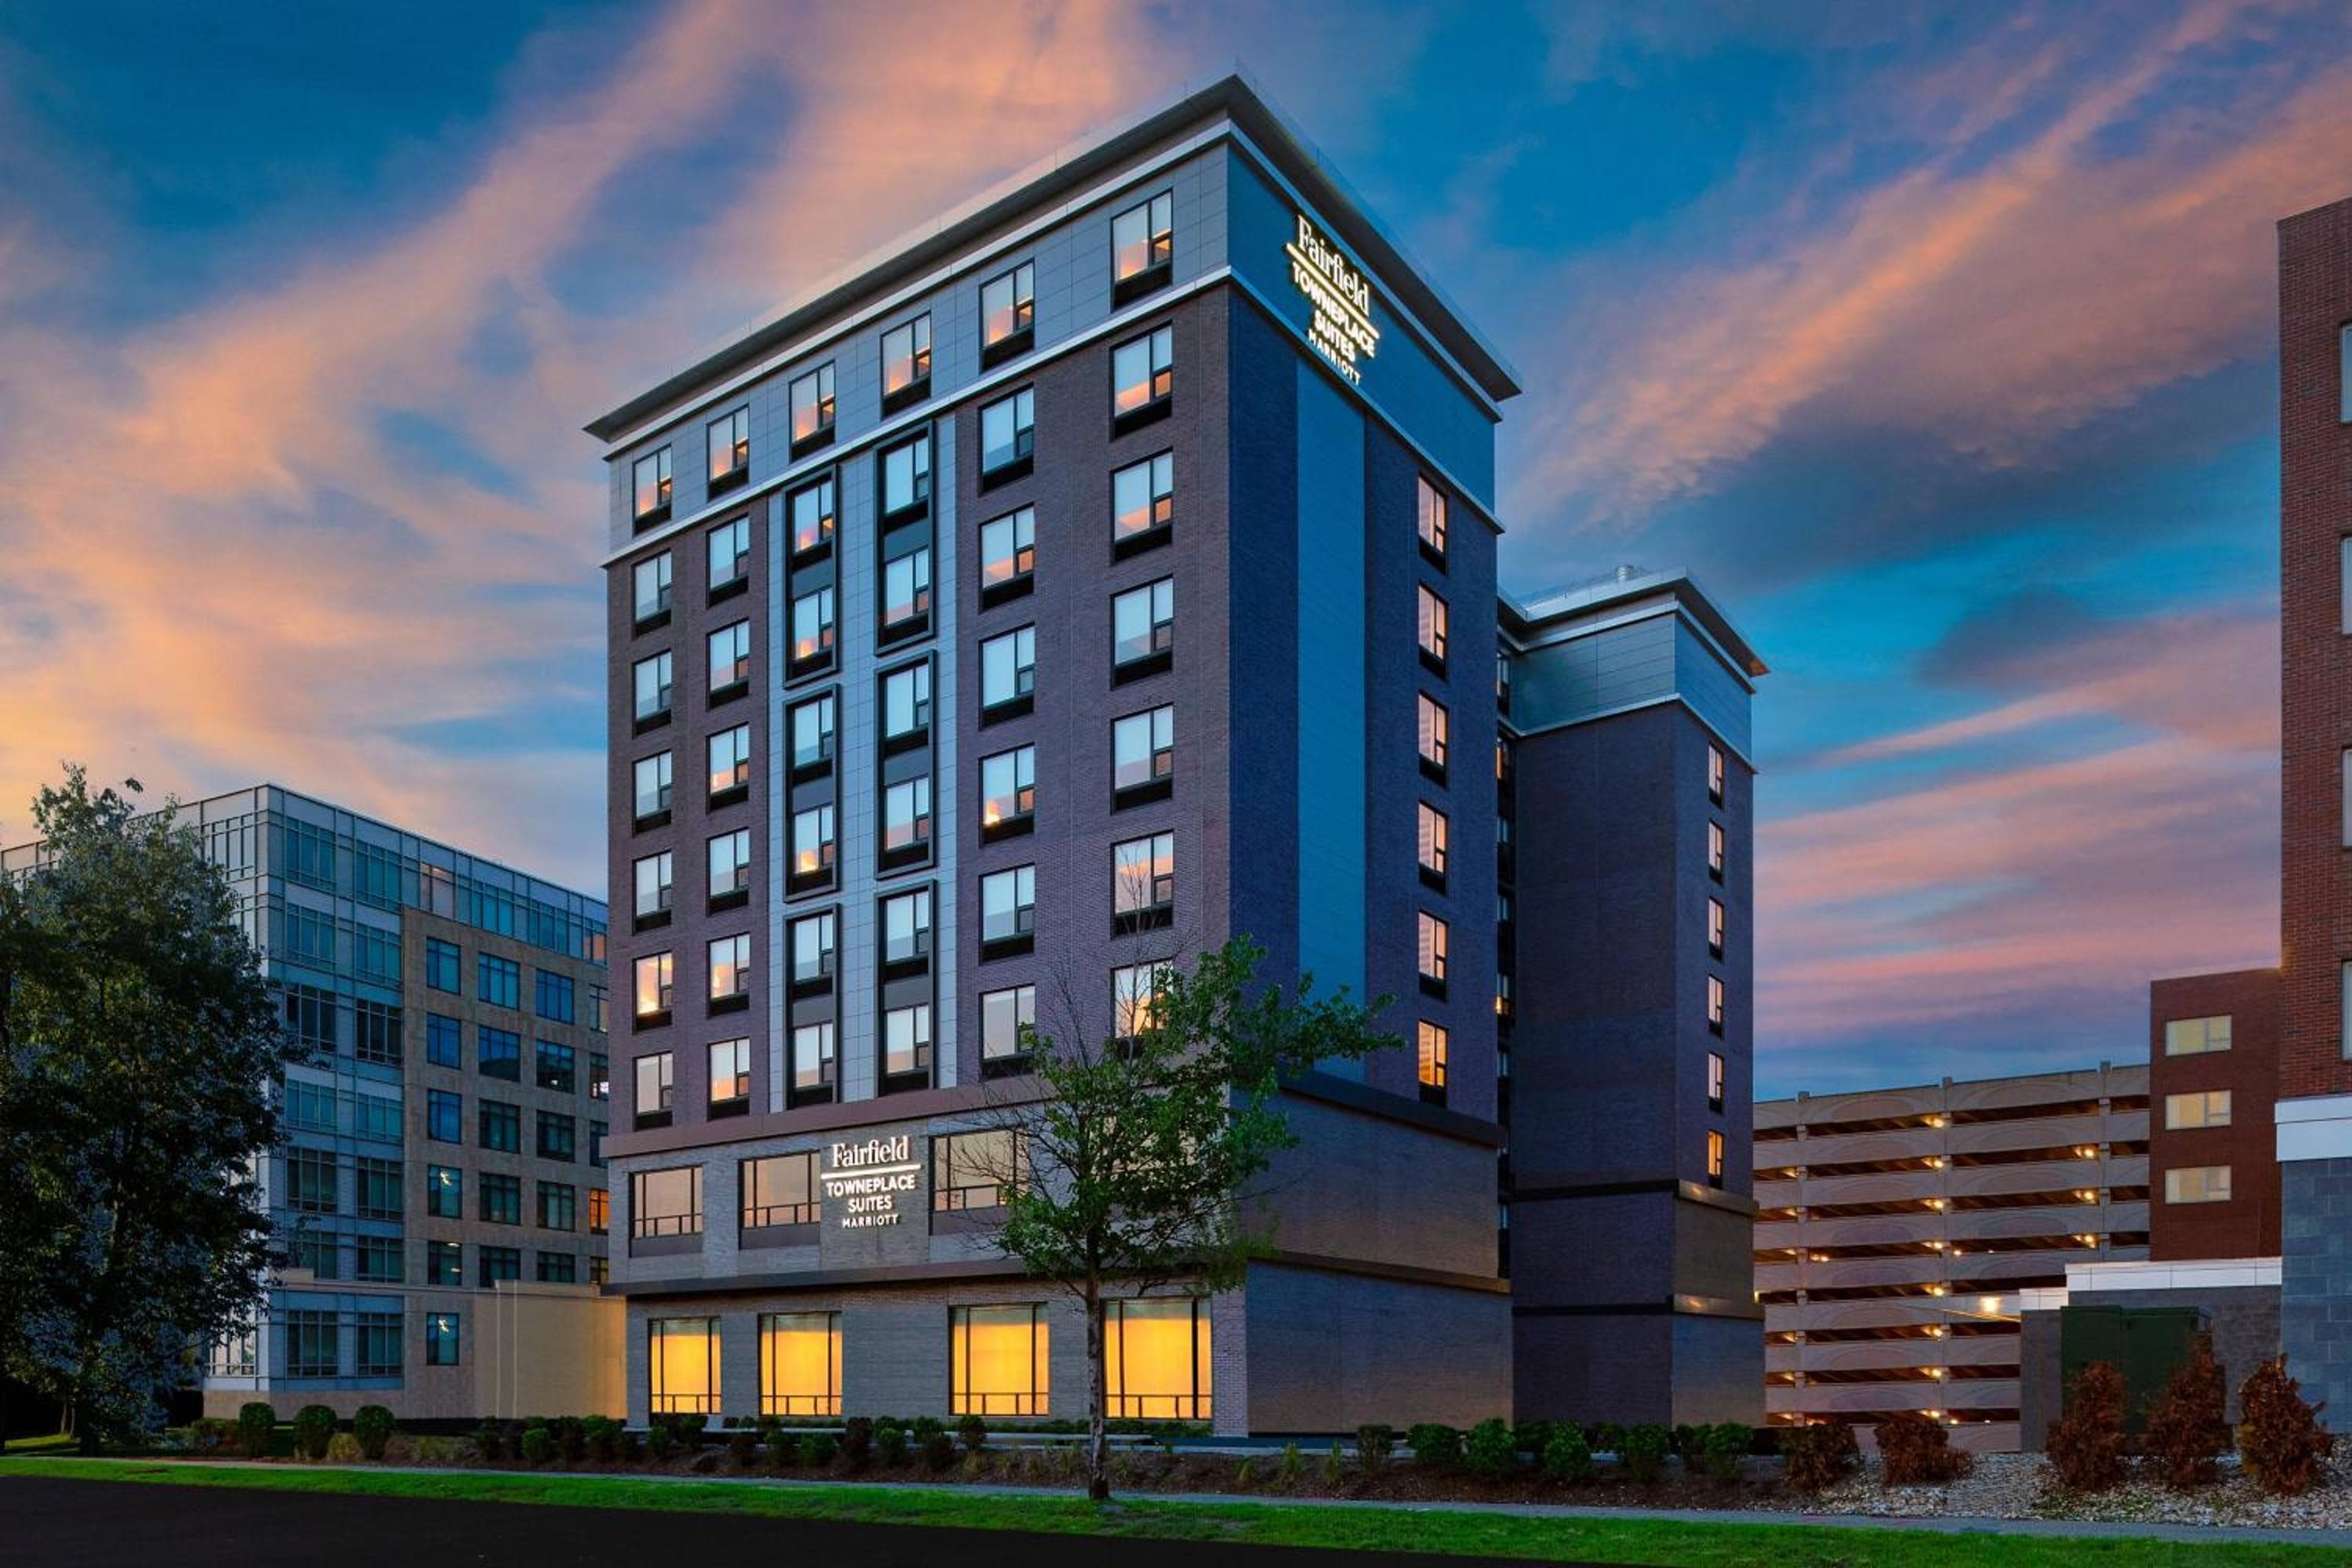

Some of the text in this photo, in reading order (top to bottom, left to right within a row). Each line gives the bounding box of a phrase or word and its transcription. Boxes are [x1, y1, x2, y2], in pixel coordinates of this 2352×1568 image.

[1298, 214, 1370, 316] Fairfield
[1293, 261, 1375, 358] TOWNEPLACE
[1308, 328, 1361, 386] MARRIOTT
[1315, 310, 1356, 362] SUITES
[832, 1135, 909, 1167] Fairfield
[826, 1174, 916, 1196] TOWNEPLACE
[848, 1195, 892, 1213] SUITES
[842, 1214, 899, 1229] MARRIOTT
